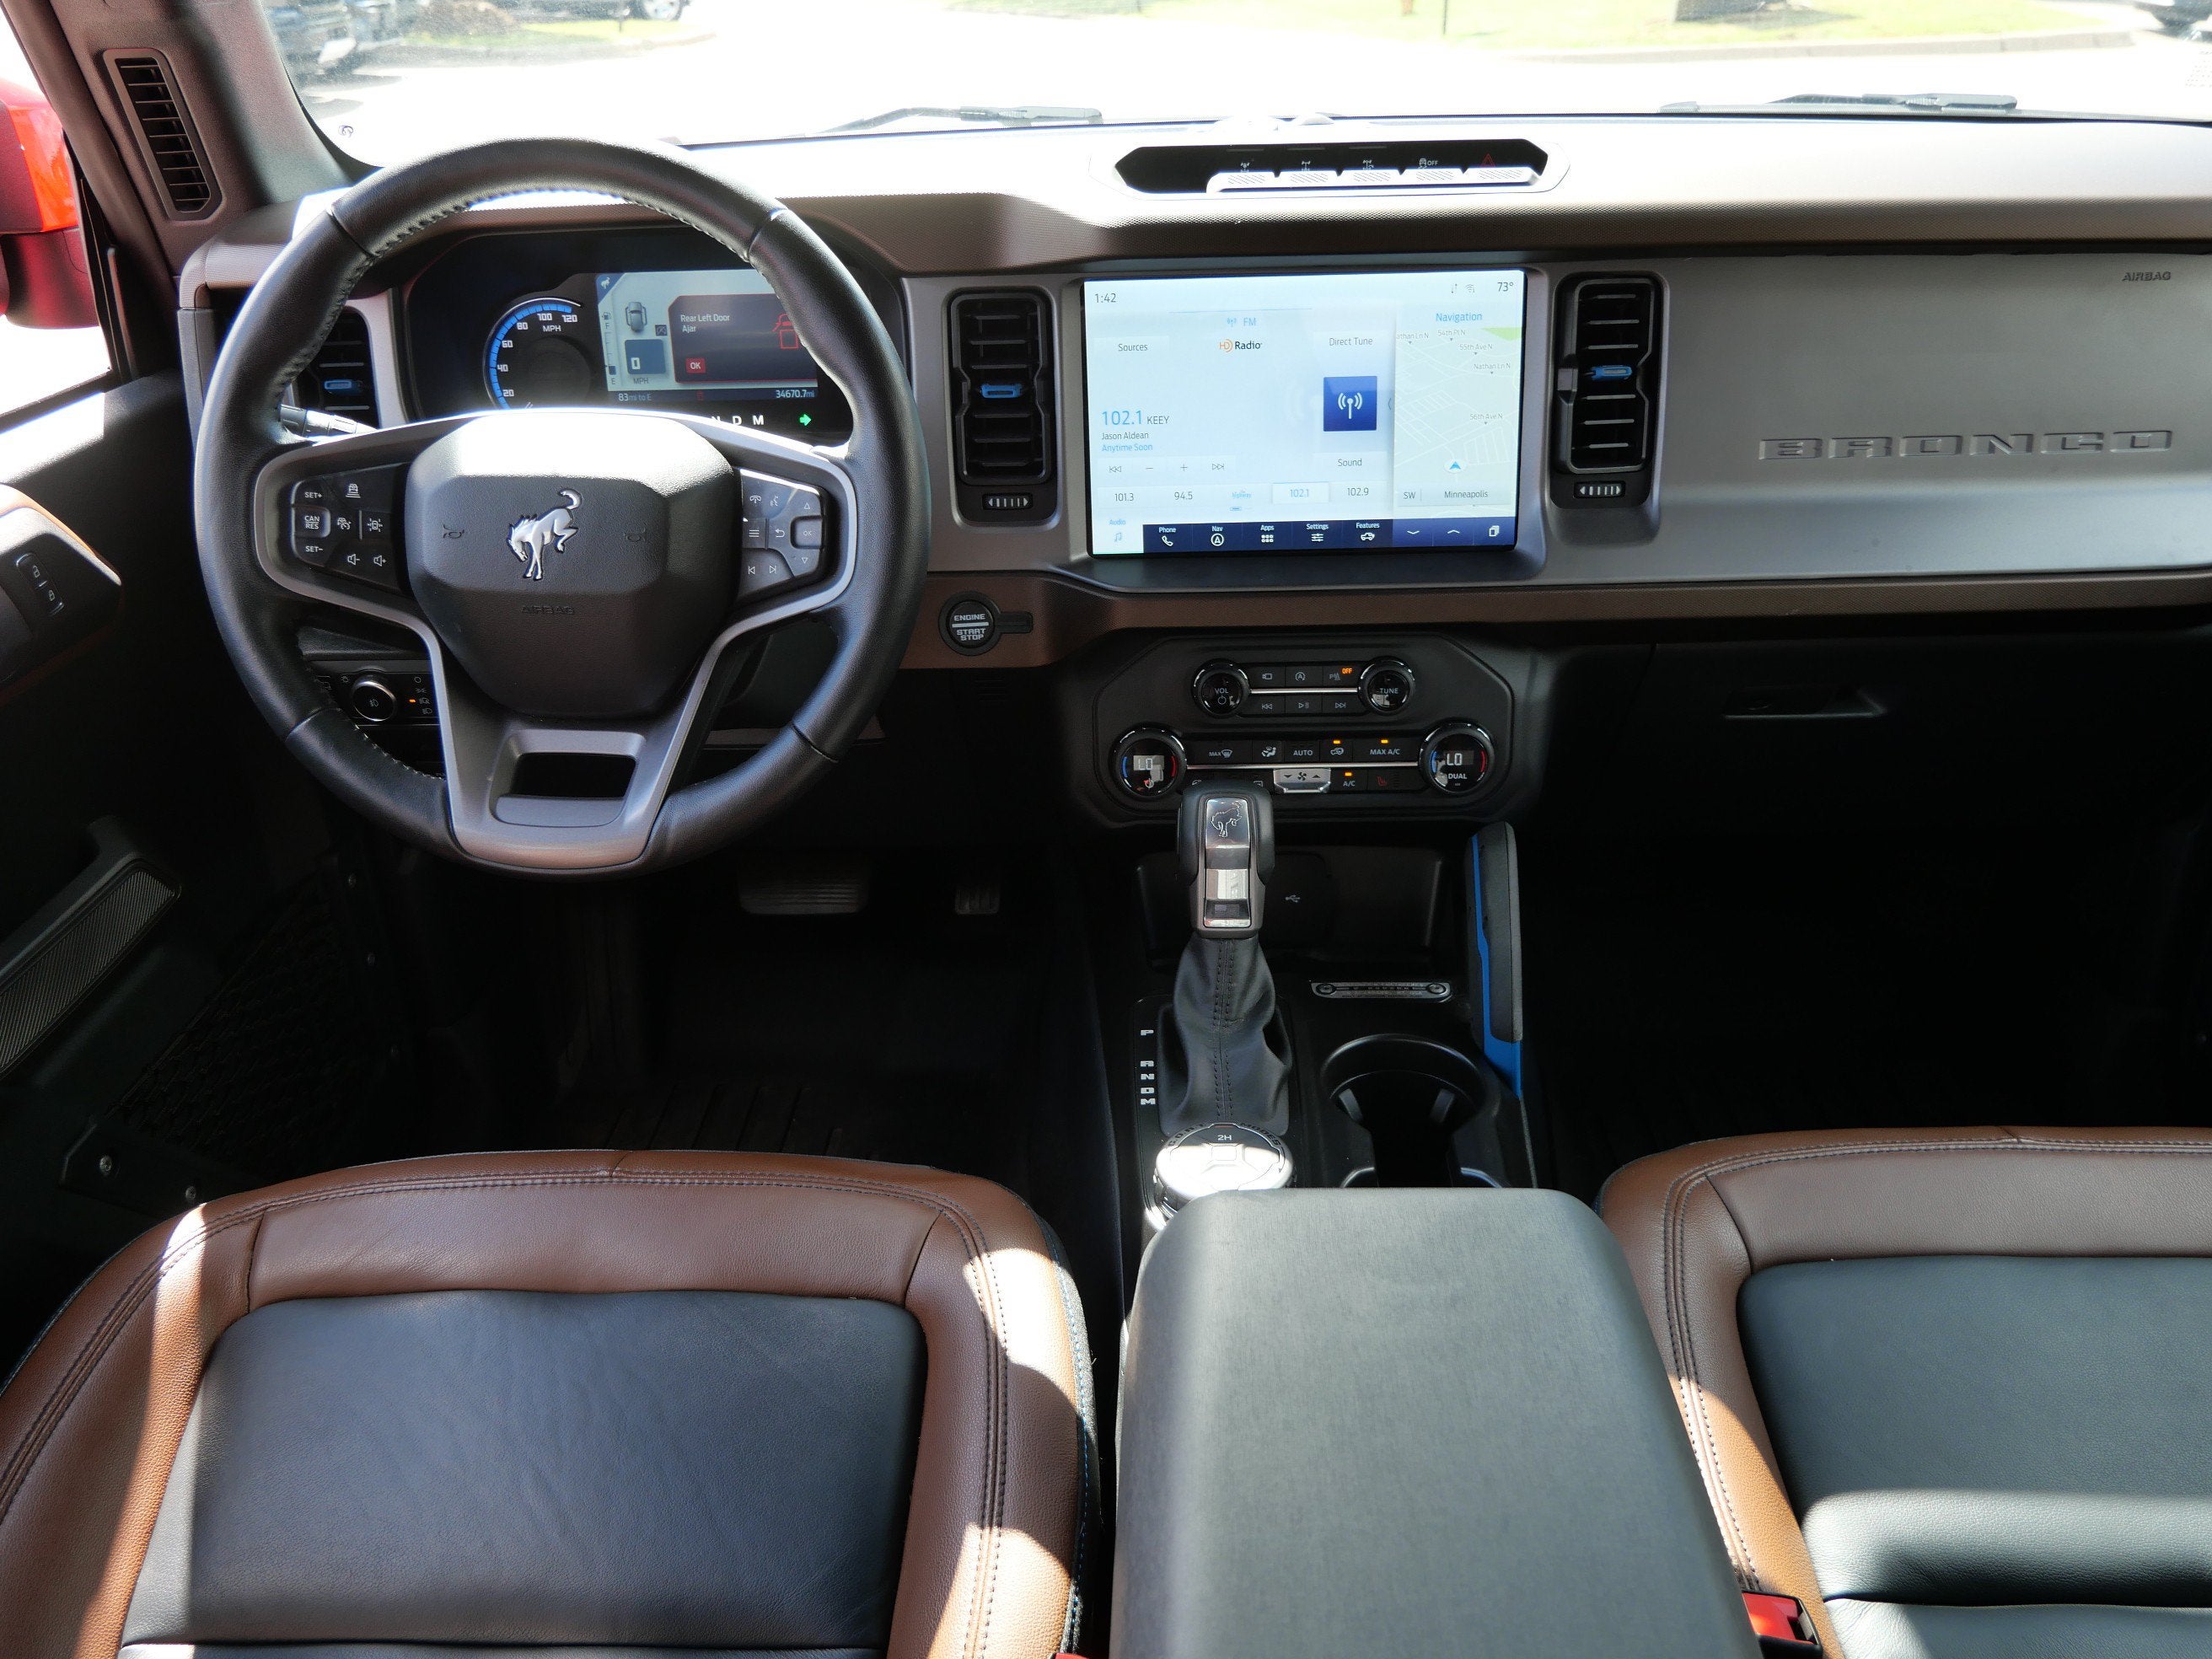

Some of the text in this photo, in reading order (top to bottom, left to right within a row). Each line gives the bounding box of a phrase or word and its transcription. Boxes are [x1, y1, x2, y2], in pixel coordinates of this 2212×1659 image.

[2122, 271, 2172, 282] AIRBAG
[1497, 282, 1514, 292] 73°
[1094, 293, 1117, 303] 1:42
[536, 313, 553, 321] 100
[561, 314, 578, 323] 120
[698, 314, 712, 322] Left
[1243, 317, 1256, 326] FM
[1436, 312, 1483, 323] Navigation
[516, 322, 529, 330] 80
[682, 325, 696, 334] Ajar
[502, 340, 513, 348] 60
[1329, 336, 1373, 346] Direct Tune
[1118, 343, 1148, 352] Sources
[502, 389, 515, 397] 20
[647, 393, 652, 401] E
[732, 415, 743, 426] D
[752, 415, 765, 426] M
[1102, 410, 1170, 426] 102.1 KEEY
[1101, 432, 1122, 440] Jason
[1101, 443, 1153, 454] Anytime Soon
[1758, 430, 2172, 460] BRONCO
[1337, 458, 1362, 467] Sound
[1173, 491, 1193, 500] 94.5
[1290, 489, 1310, 498] 102.1
[1346, 487, 1369, 497] 102.9
[1404, 491, 1416, 500] SW
[1444, 490, 1489, 500] Minneapolis
[1114, 492, 1135, 502] 101.3
[1138, 758, 1153, 770] LO
[1447, 753, 1463, 766] LO
